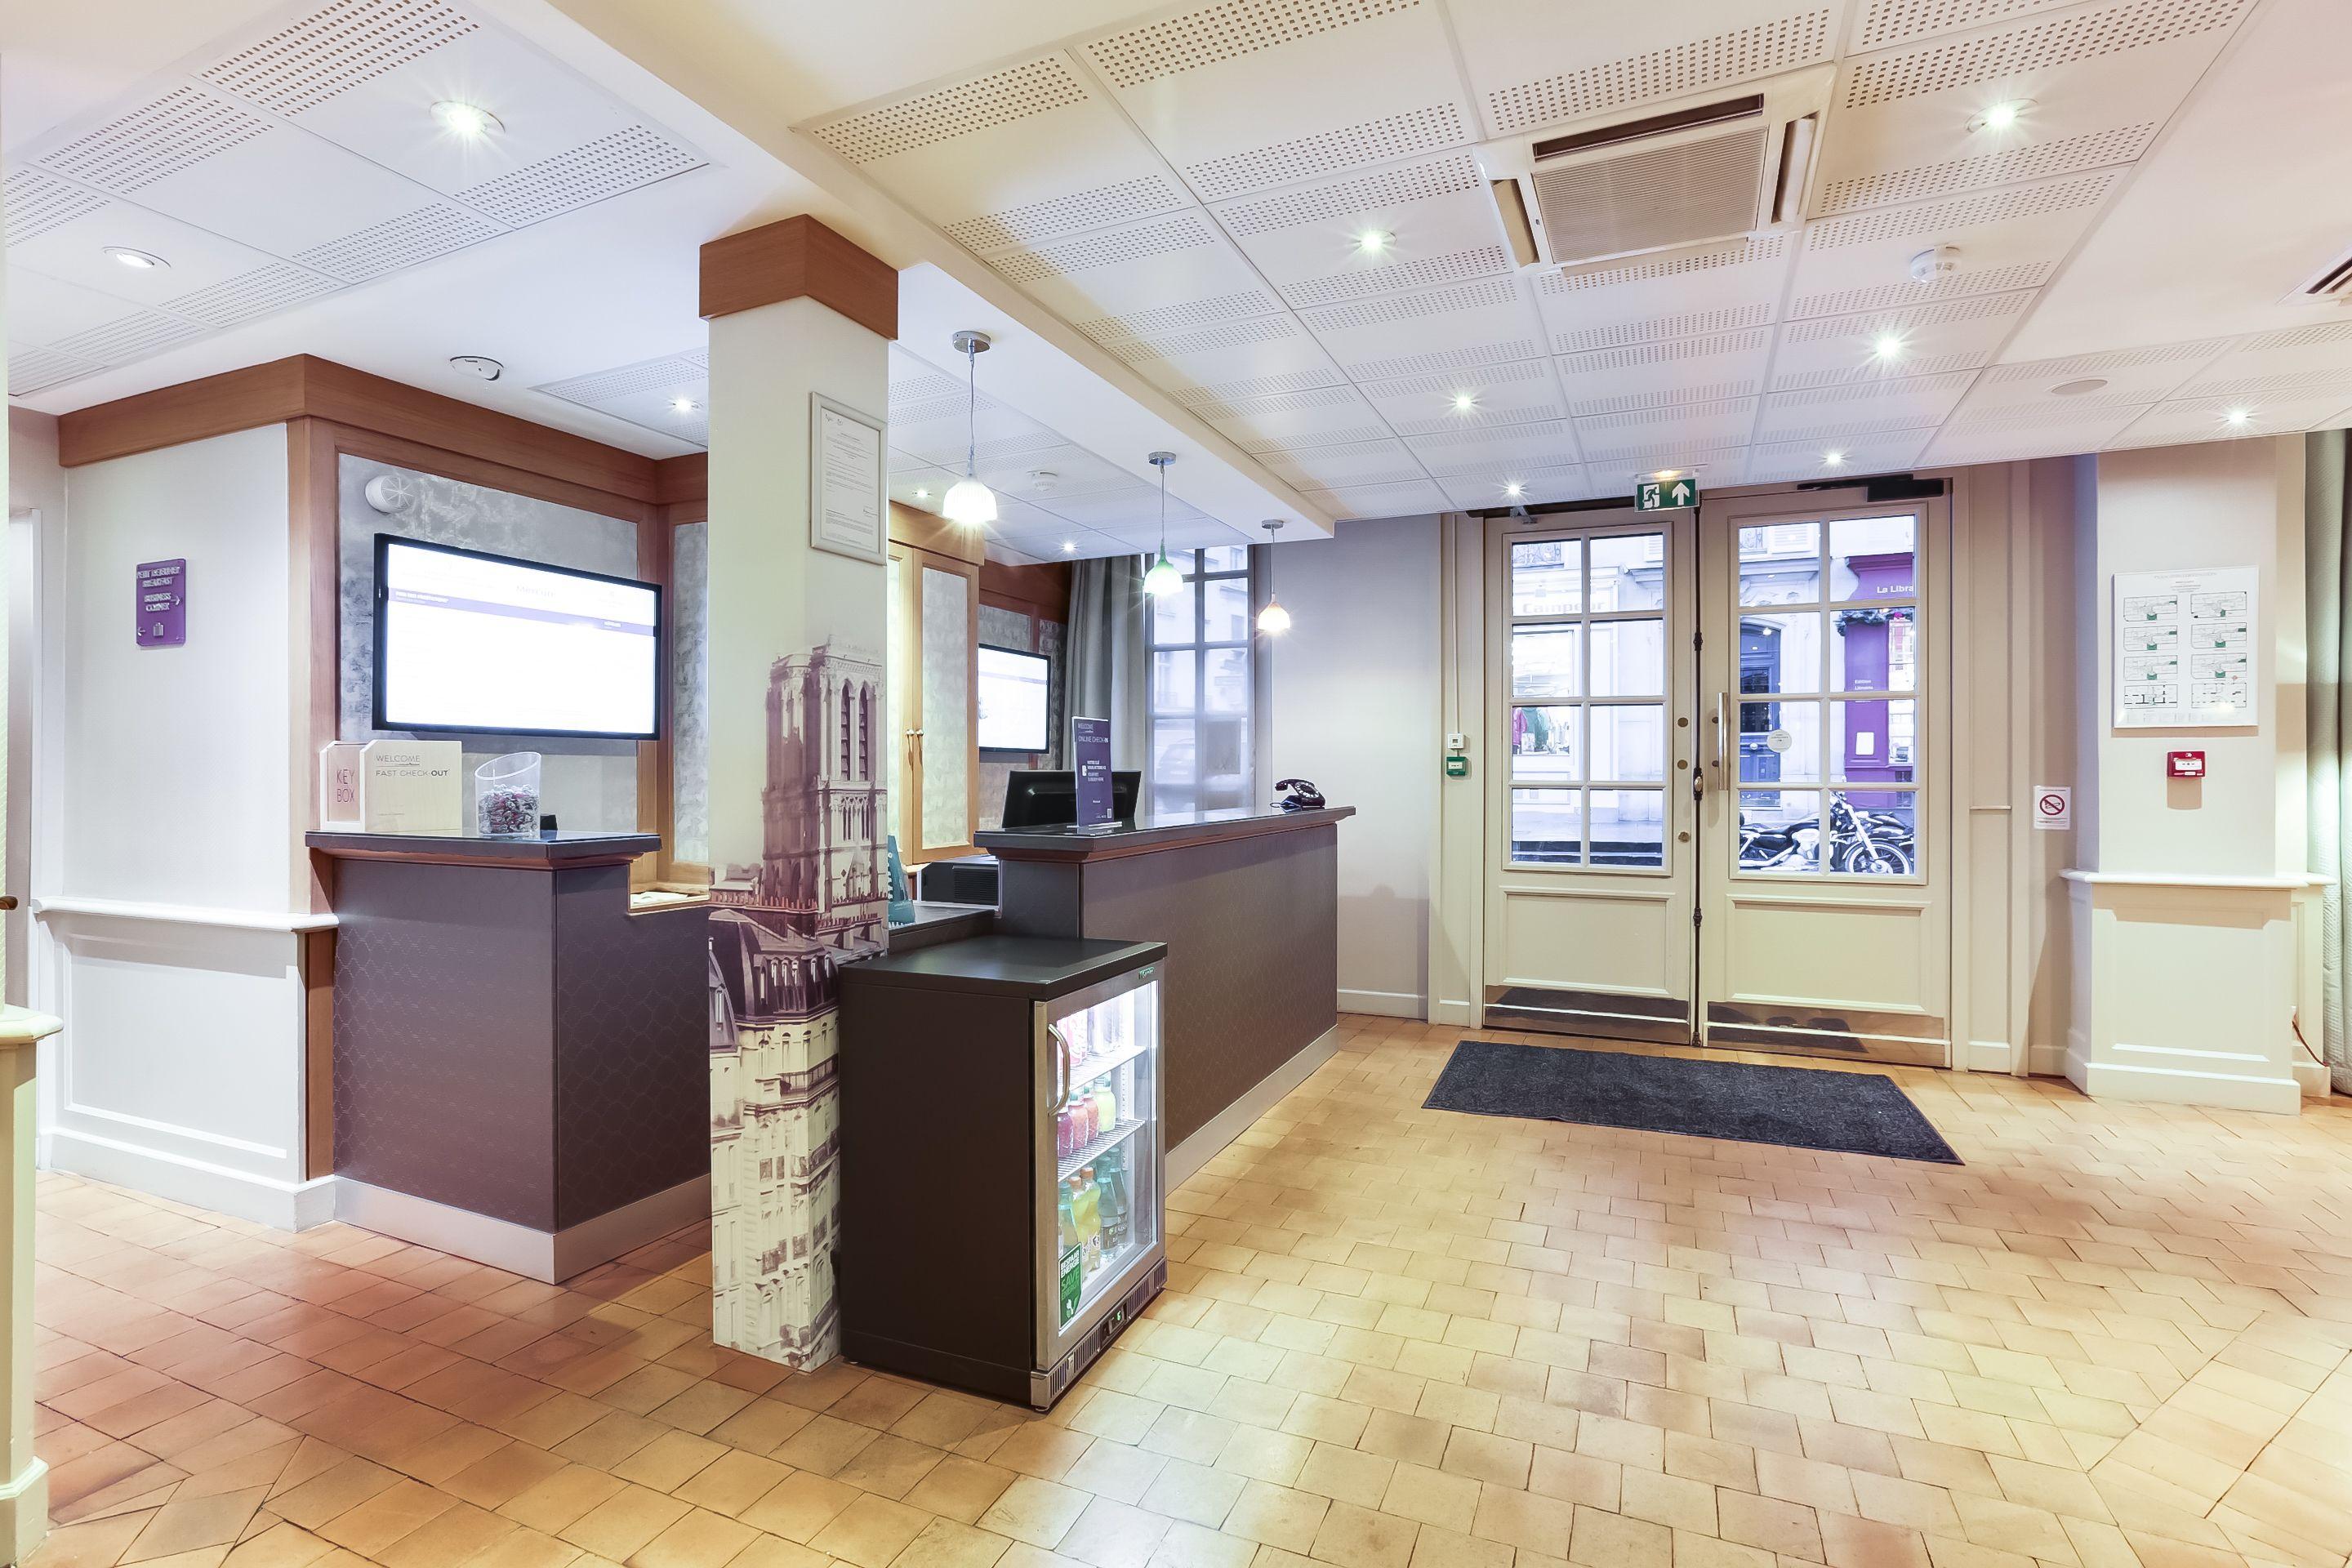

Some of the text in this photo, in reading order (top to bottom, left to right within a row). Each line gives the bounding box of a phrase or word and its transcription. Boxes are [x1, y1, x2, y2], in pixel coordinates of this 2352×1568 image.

[1877, 585, 1913, 594] La Libra
[376, 755, 421, 763] WELCOME
[336, 768, 355, 785] KEY
[376, 769, 398, 777] FAST
[336, 788, 355, 803] BOX
[1061, 1249, 1080, 1272] BESPAAR
[1061, 1258, 1080, 1279] ENERGIE
[1061, 1265, 1080, 1290] SAVE
